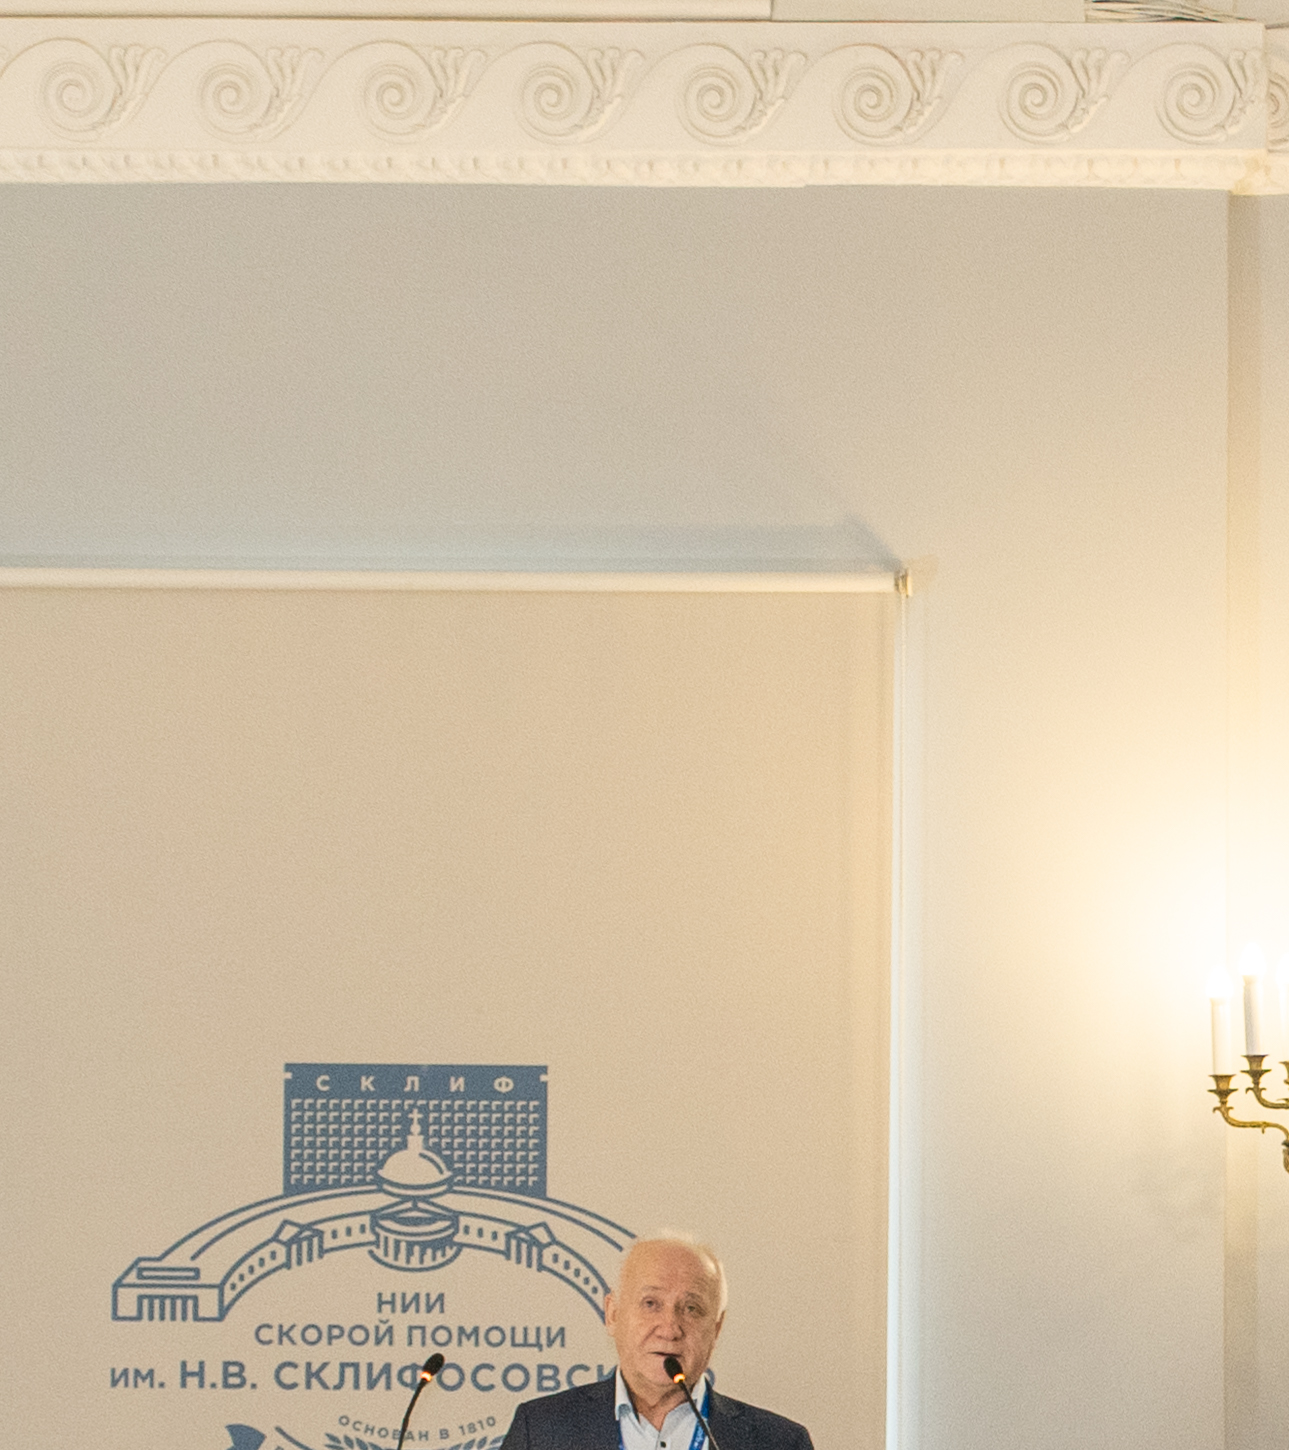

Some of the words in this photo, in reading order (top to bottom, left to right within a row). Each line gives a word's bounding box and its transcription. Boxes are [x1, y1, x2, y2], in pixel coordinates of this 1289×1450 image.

[315, 1074, 515, 1094] СКЛИФ
[376, 1291, 445, 1314] НИИ
[254, 1318, 394, 1347] СКОРОЙ
[407, 1324, 566, 1355] ПОМОЩИ
[109, 1366, 166, 1389] им.
[179, 1360, 258, 1390] Н.В.
[337, 1414, 430, 1443] ОСНОВАН
[439, 1428, 451, 1441] В
[457, 1415, 498, 1436] 1810
